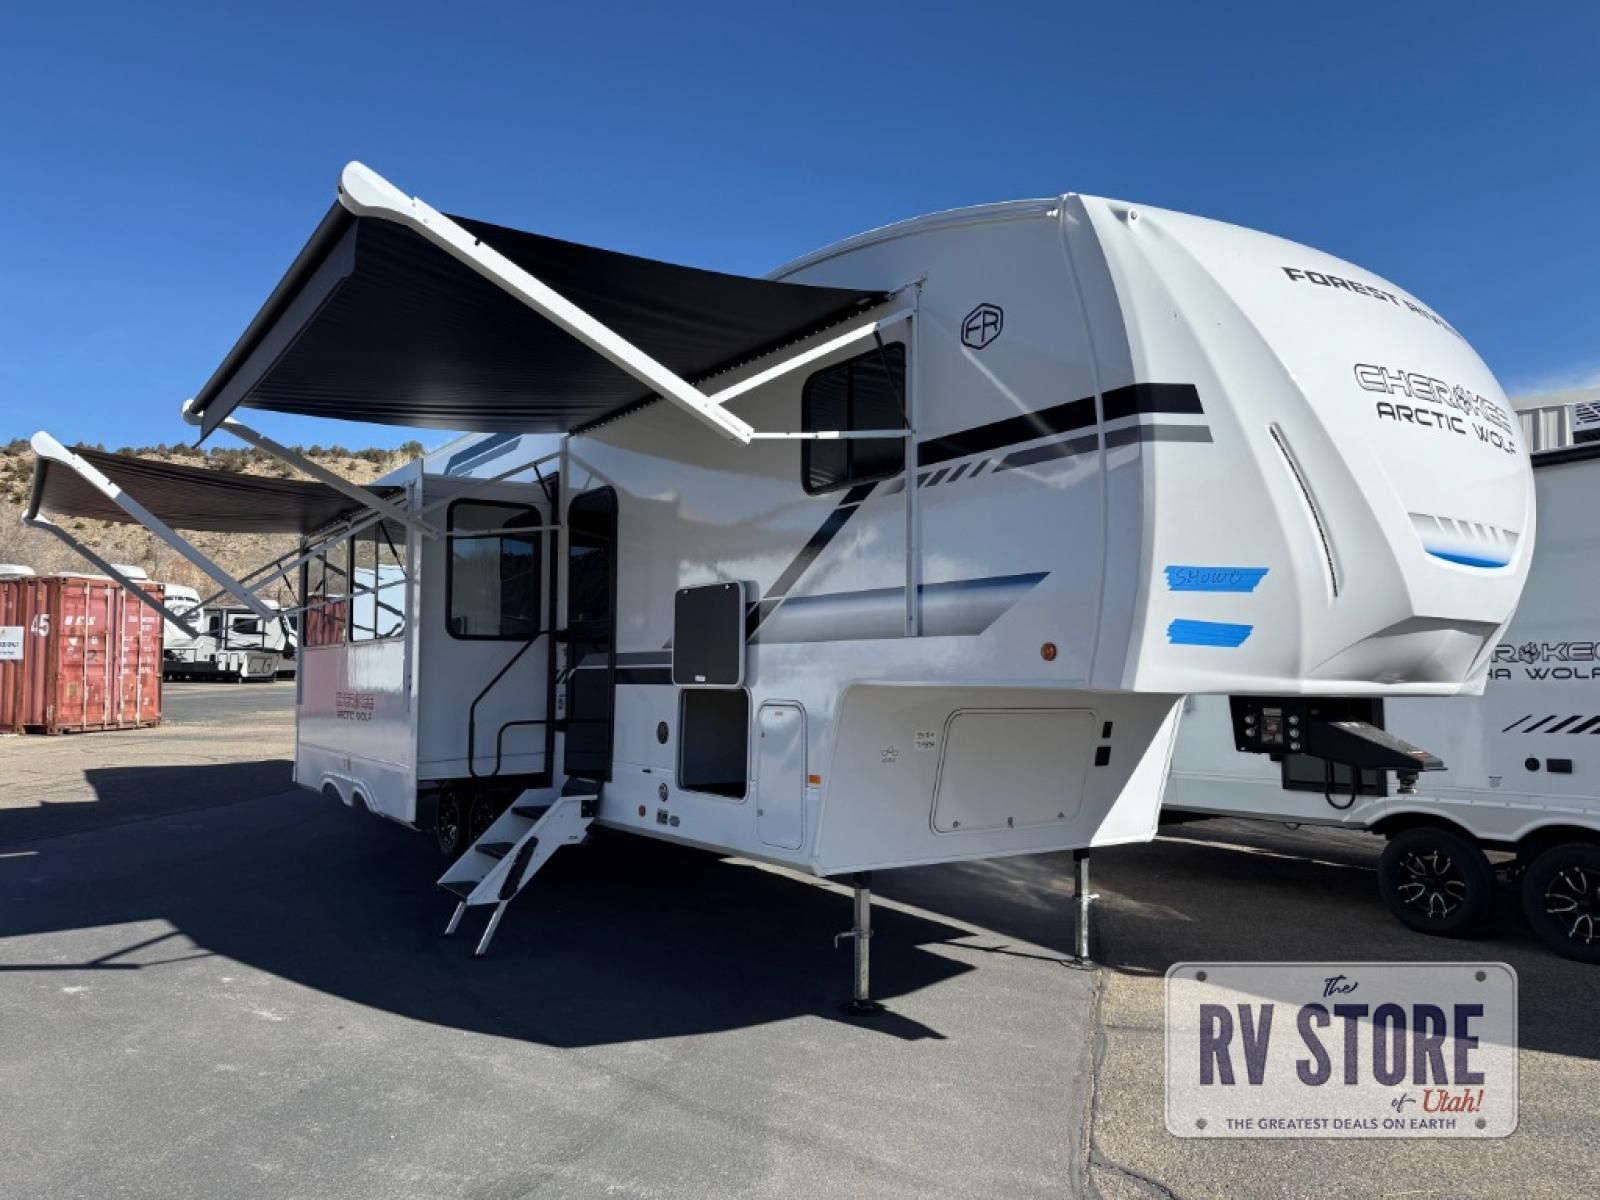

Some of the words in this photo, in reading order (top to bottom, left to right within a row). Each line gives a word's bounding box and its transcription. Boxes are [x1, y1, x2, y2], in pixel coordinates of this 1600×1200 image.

[1281, 266, 1400, 306] FOREST
[1376, 401, 1466, 434] ARCTIC
[1472, 422, 1516, 454] WOLF
[31, 613, 50, 637] 45
